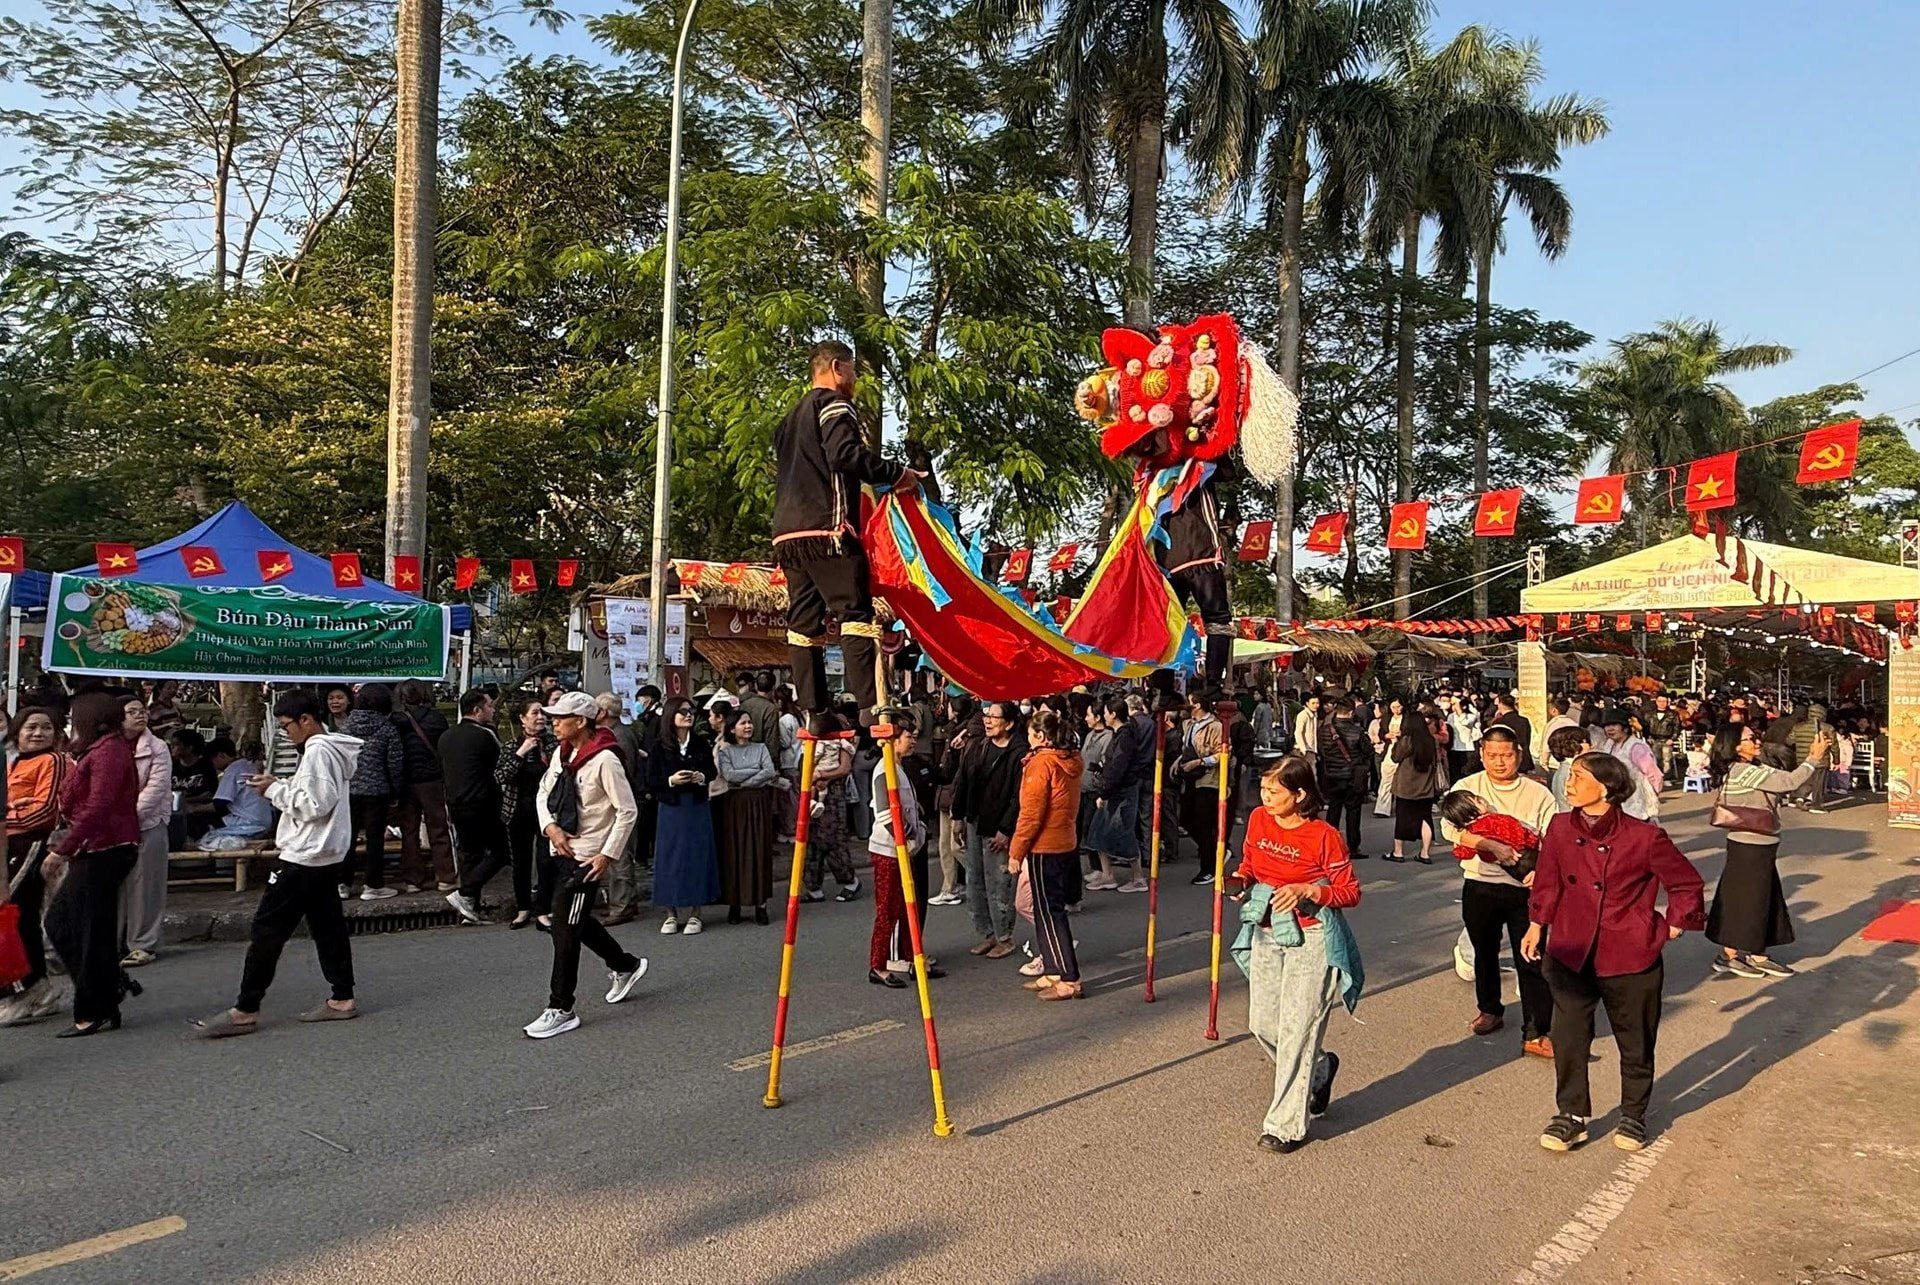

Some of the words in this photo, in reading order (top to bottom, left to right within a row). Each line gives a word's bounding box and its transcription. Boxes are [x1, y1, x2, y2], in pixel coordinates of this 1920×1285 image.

[217, 608, 258, 626] Bún
[265, 611, 305, 630] Đậu
[311, 615, 369, 631] Thành
[375, 619, 414, 631] Nam
[196, 632, 224, 646] Hiệp
[228, 635, 249, 648] Hội
[253, 636, 274, 647] Văn
[278, 637, 301, 648] Hóa
[380, 640, 404, 649] Ninh
[97, 659, 127, 670] Zalo
[1893, 695, 1920, 705] 202
